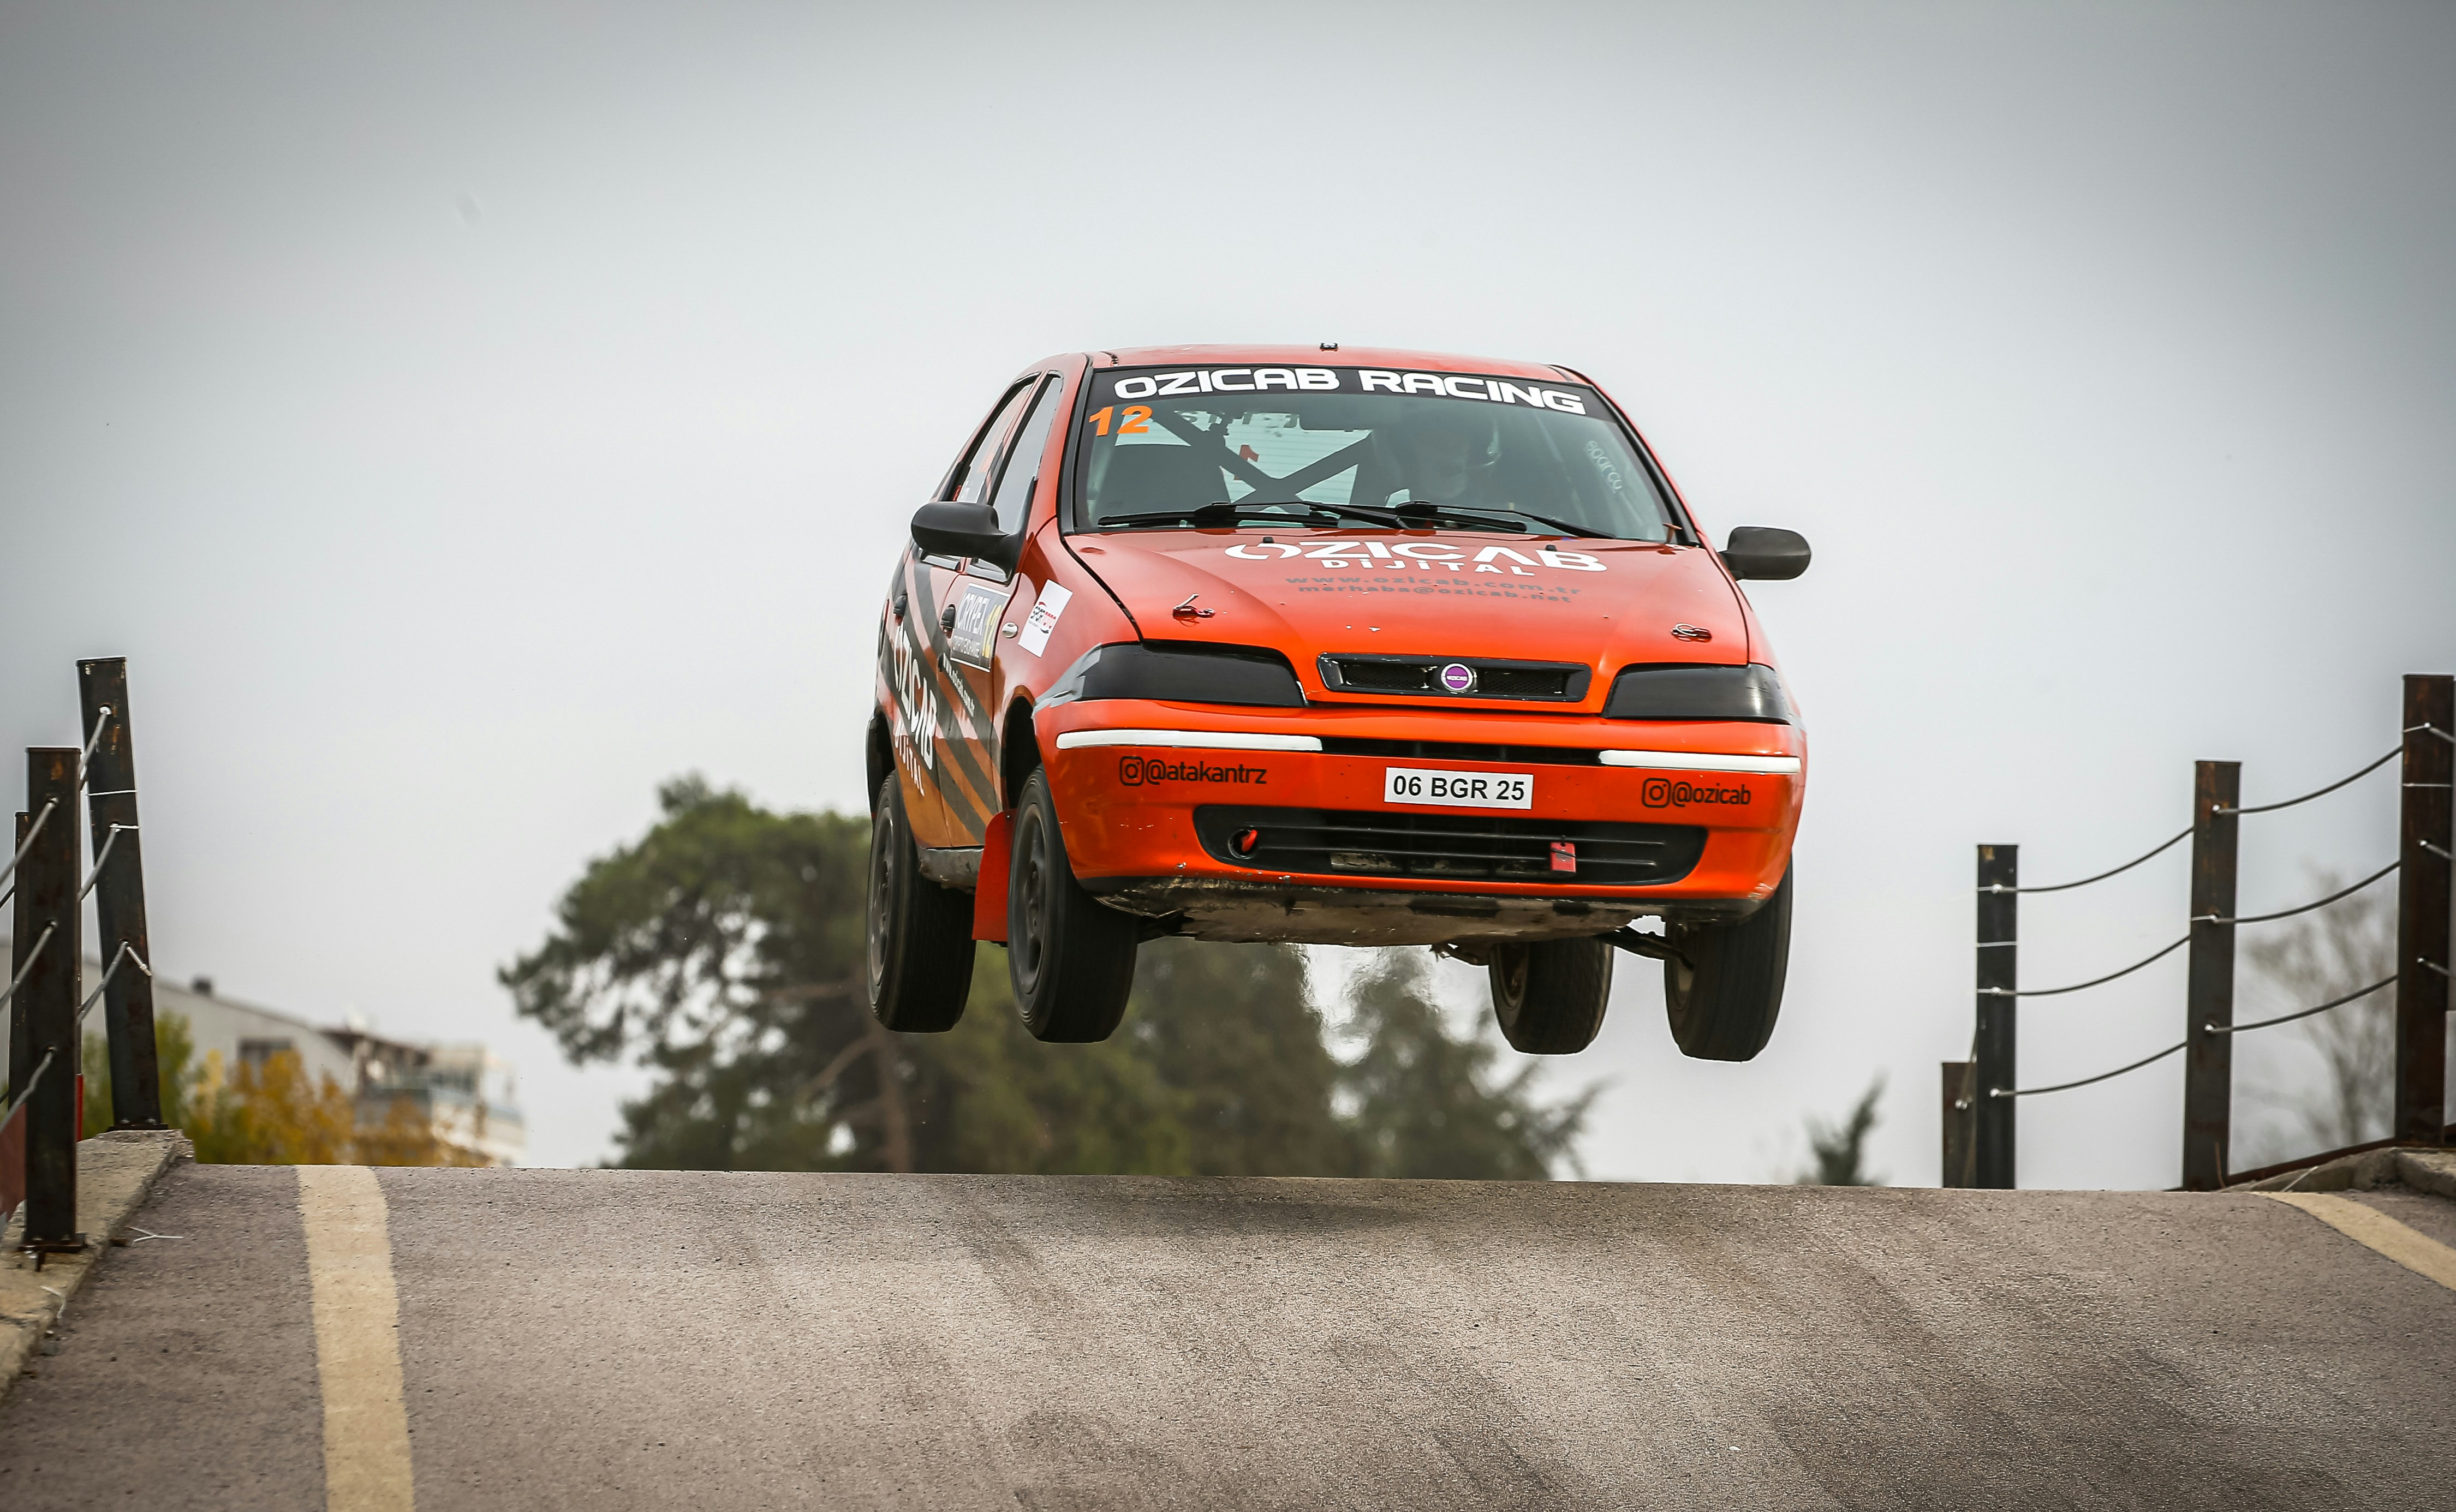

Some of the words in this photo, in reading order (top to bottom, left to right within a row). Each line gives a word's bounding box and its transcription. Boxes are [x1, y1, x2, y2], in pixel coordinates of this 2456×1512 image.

[1113, 368, 1340, 399] OZICAB
[1357, 369, 1587, 415] RACING
[1088, 405, 1153, 437] 12
[1224, 540, 1608, 573] OZICAB
[1285, 576, 1582, 594] www.ozicab.com.tr
[1298, 585, 1572, 603] merhaba@ozicab.net
[1146, 759, 1267, 785] @atakantrz
[1393, 775, 1422, 796] 06
[1430, 777, 1488, 799] BGR
[1495, 780, 1525, 800] 25
[1671, 781, 1751, 808] @ozicab
